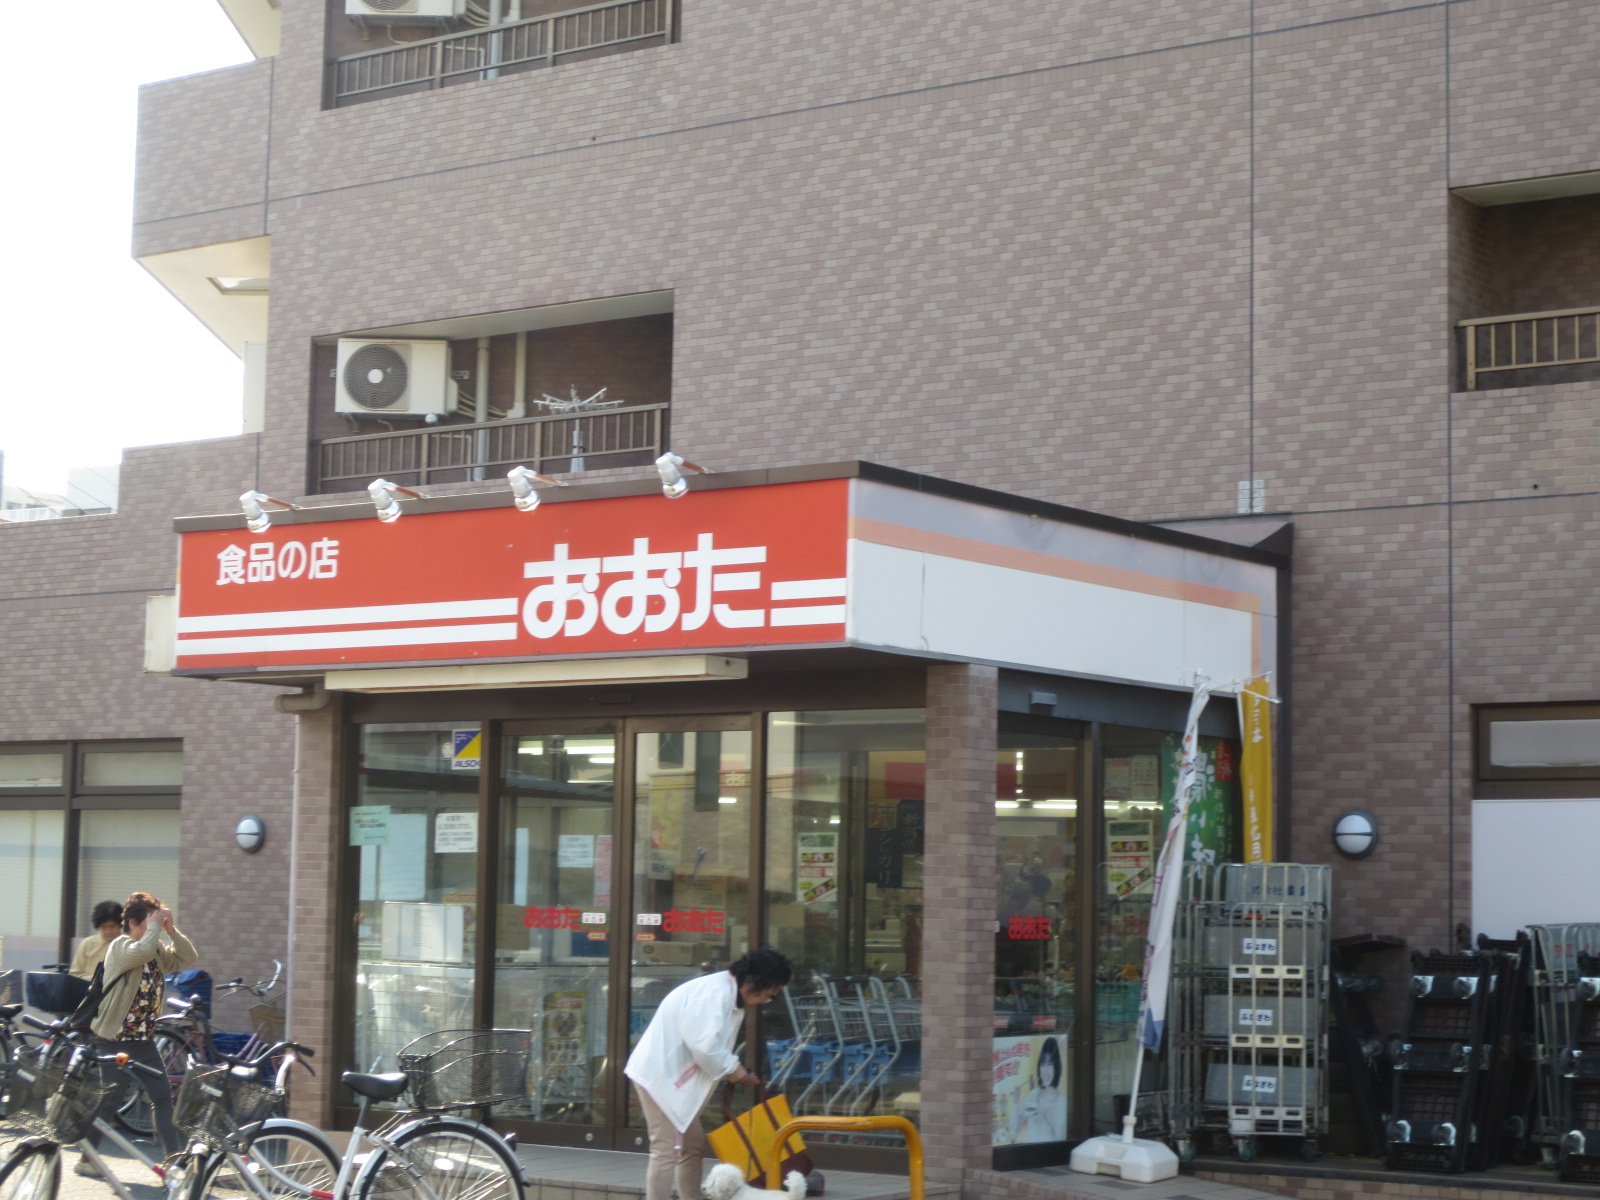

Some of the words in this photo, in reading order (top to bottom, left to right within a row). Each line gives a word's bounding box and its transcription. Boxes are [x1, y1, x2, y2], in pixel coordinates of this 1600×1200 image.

[215, 537, 340, 586] 食品の店
[521, 532, 768, 641] おおた
[522, 905, 583, 930] おおた
[662, 908, 726, 933] おおた
[1008, 914, 1051, 940] おおた
